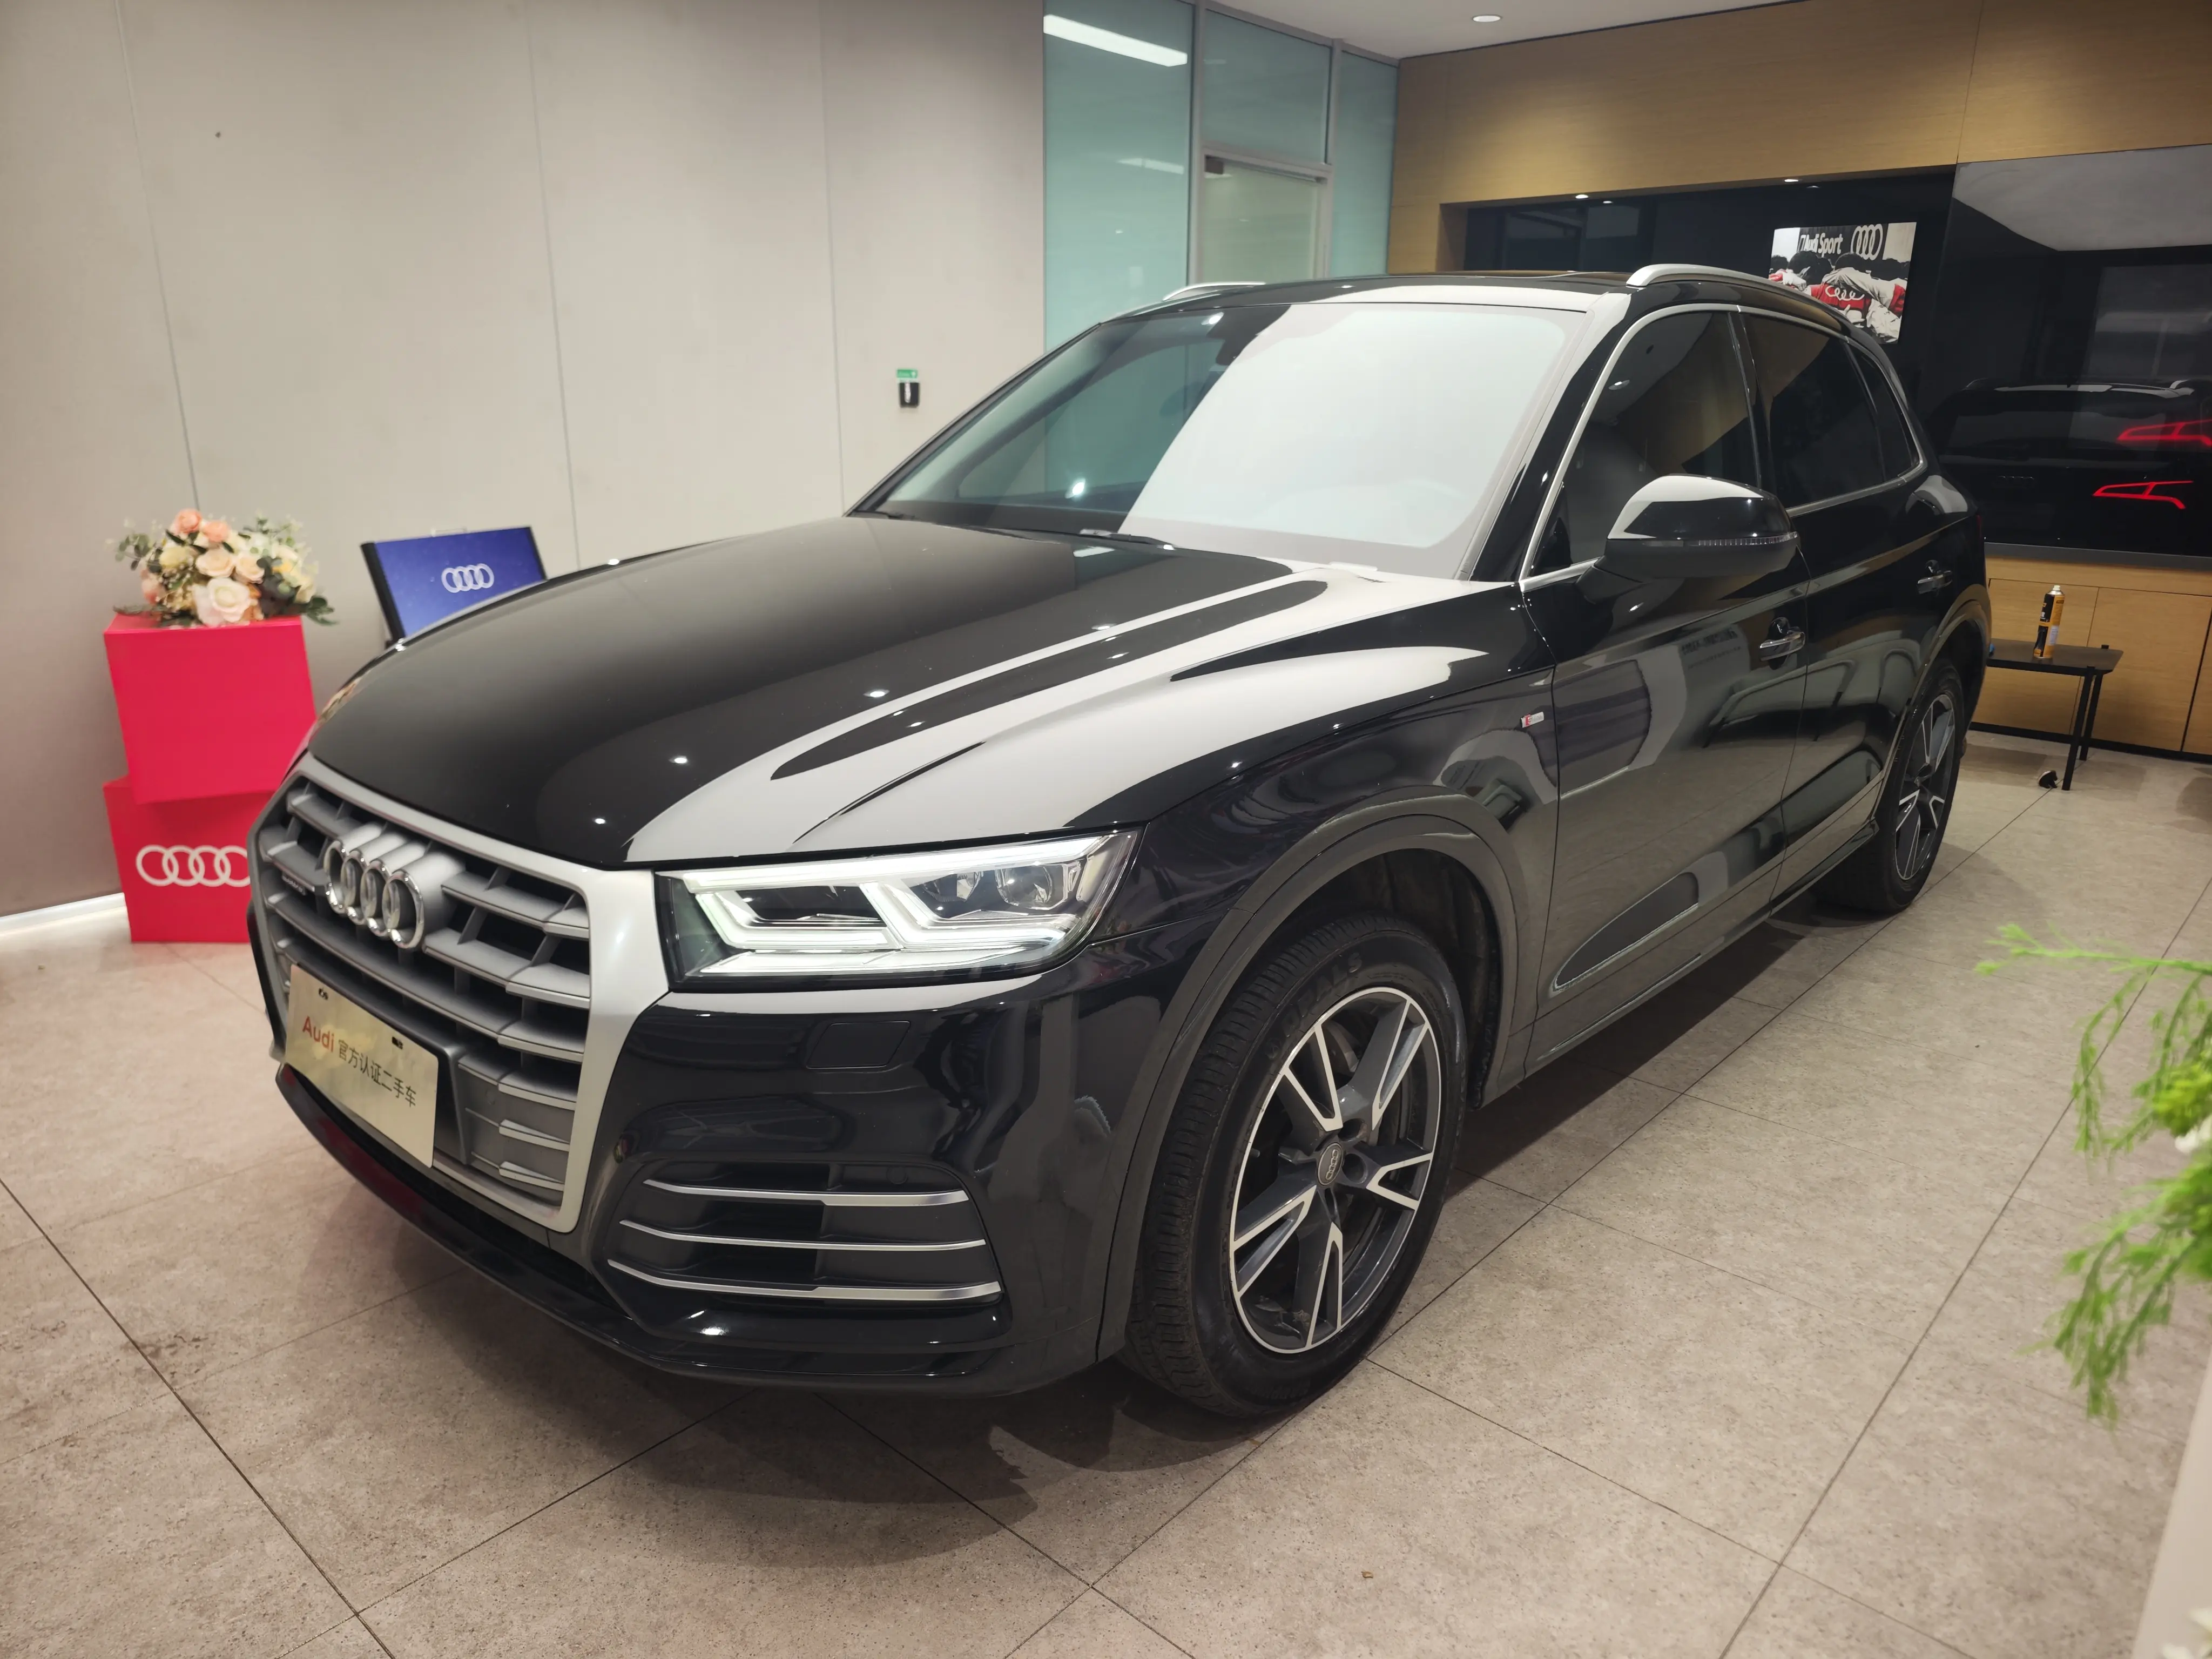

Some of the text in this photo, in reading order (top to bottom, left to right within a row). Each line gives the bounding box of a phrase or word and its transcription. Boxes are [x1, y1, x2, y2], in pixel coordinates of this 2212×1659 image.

[1804, 232, 1843, 258] Audi Sport
[302, 1015, 416, 1107] Audi 官方认证二手车
